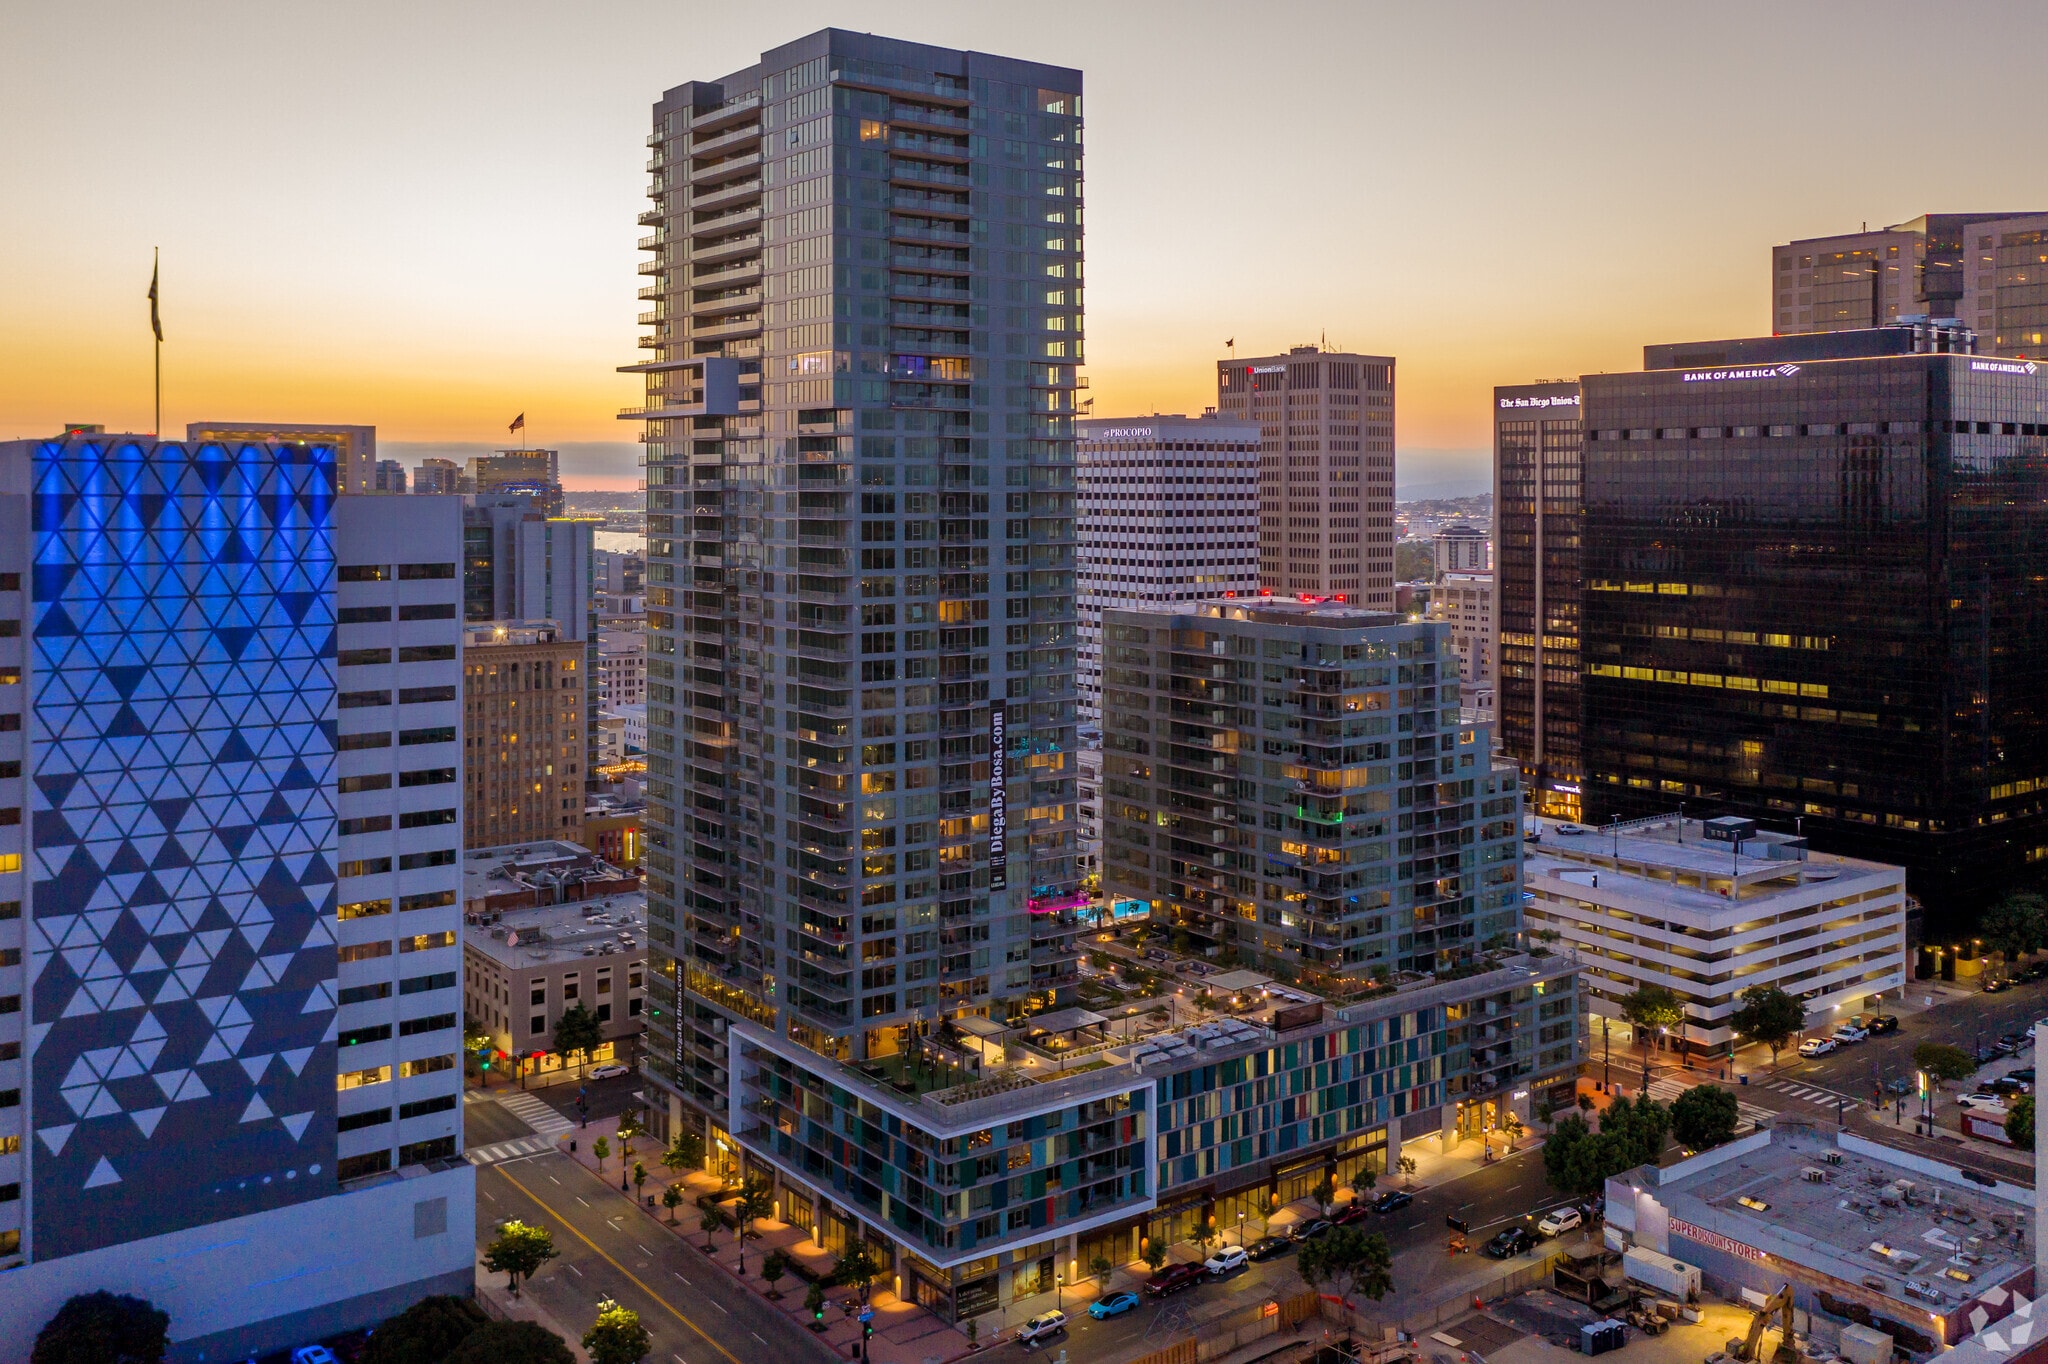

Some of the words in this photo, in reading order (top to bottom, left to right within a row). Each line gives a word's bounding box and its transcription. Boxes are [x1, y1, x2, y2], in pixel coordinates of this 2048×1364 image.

[1254, 365, 1286, 373] UnionBank
[1972, 362, 1989, 371] BANK
[1990, 363, 1998, 371] OF
[1998, 364, 2025, 373] AMERICA
[1684, 372, 1711, 381] BANK
[1713, 371, 1727, 380] OF
[1728, 369, 1777, 379] AMERICA
[1500, 398, 1514, 408] The
[1515, 397, 1529, 408] San
[1529, 397, 1550, 408] Diego
[1110, 427, 1152, 437] PROCOPIO
[991, 712, 1005, 852] DiegaByBosa.com
[1554, 785, 1581, 793] wework
[1670, 1218, 1698, 1238] SUPER
[1697, 1228, 1726, 1249] DISCOUNT
[1727, 1241, 1756, 1260] STORE
